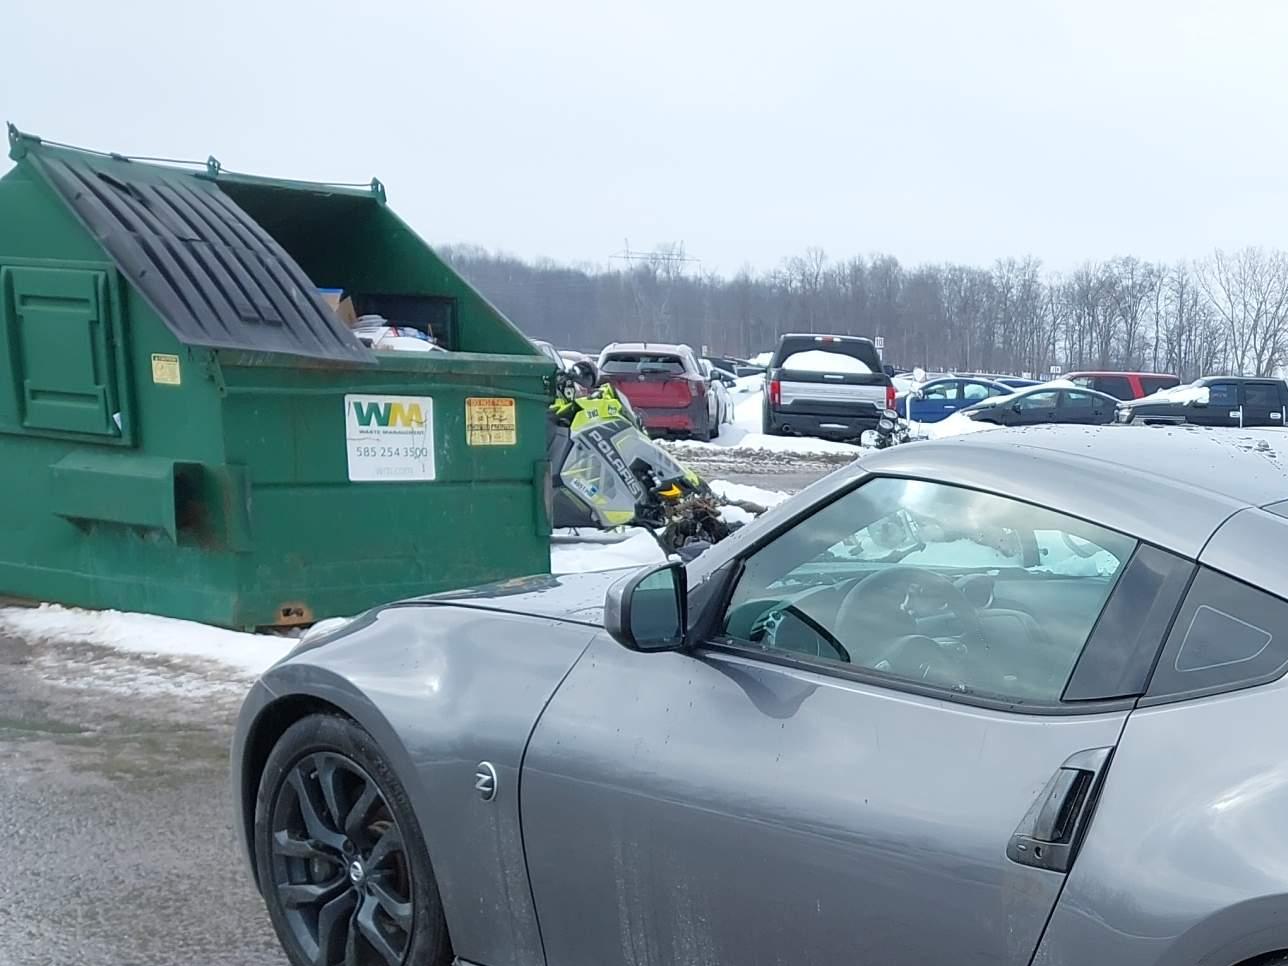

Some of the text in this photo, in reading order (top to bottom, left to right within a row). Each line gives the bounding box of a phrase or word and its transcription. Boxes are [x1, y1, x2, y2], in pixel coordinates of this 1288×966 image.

[353, 401, 425, 428] WM
[356, 446, 428, 458] 585 254 3500
[588, 430, 643, 501] POLARIS
